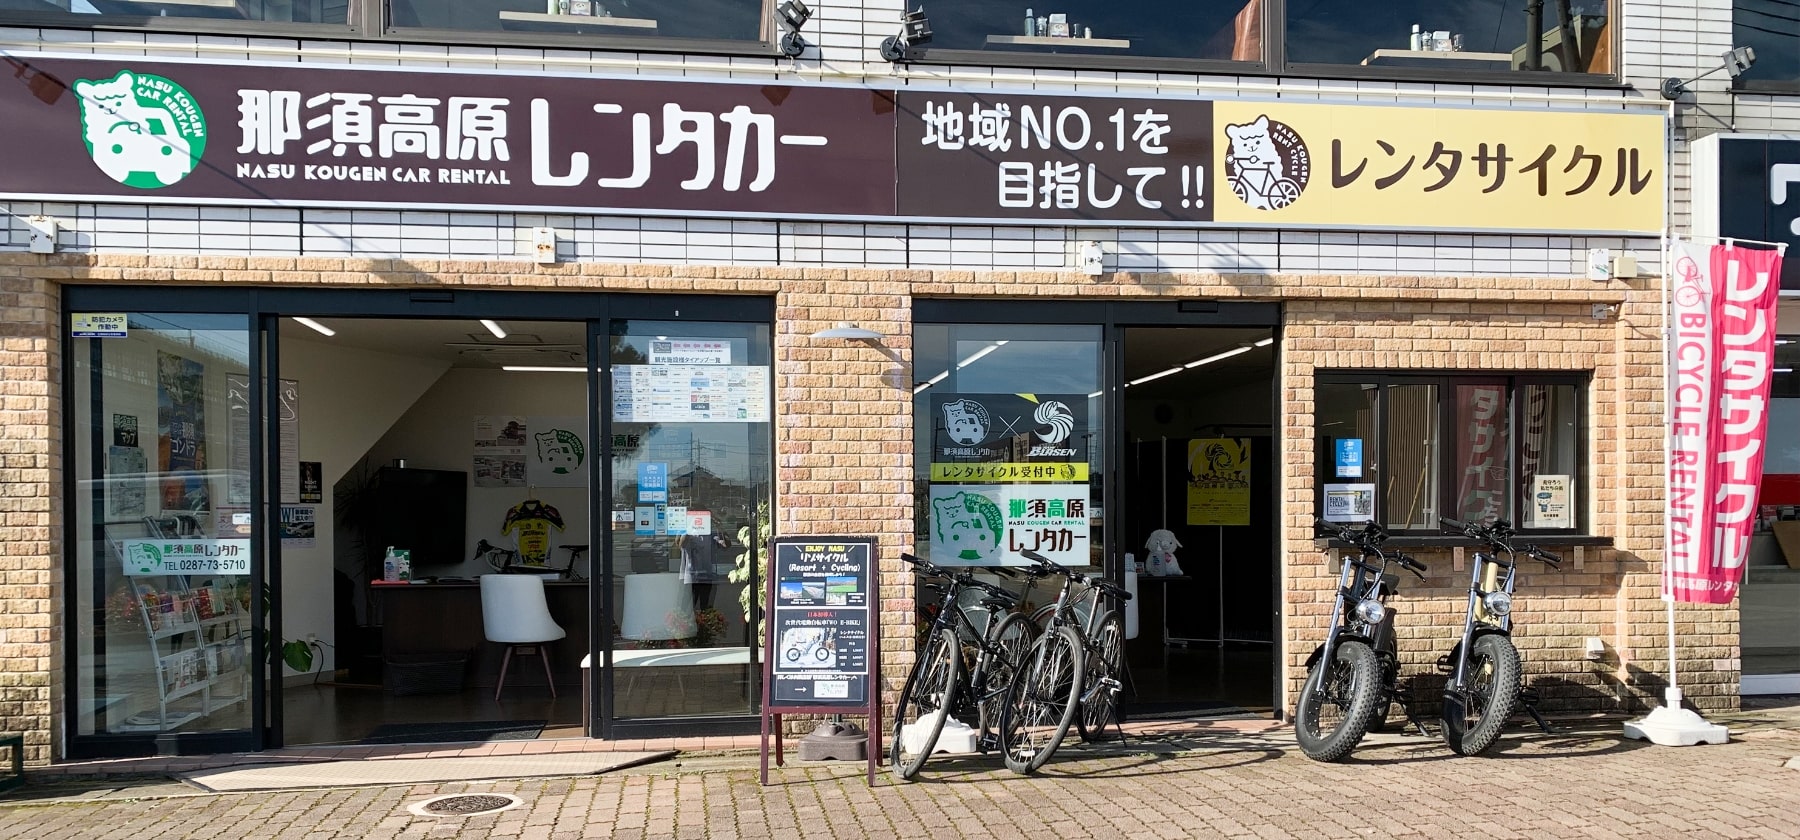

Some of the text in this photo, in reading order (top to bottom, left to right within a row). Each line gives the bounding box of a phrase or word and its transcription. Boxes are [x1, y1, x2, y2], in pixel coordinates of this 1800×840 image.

[136, 87, 192, 136] CAR RENTAL
[138, 76, 204, 137] NASU KOUGEN
[921, 101, 1171, 154] 地域NO.1を
[236, 89, 828, 192] 那須高原 レンタカー
[1273, 132, 1298, 176] RENT CYCLE
[1276, 124, 1308, 182] NASU KOUGEN
[236, 163, 510, 185] NASU KOUGEN CAR RENTAL
[1332, 138, 1652, 196] レンタサイクル
[1672, 313, 1706, 436] BICYCLE
[1713, 260, 1769, 568] レンタサイクル
[611, 434, 640, 447] 高原
[943, 466, 1055, 478] レンタサイクル受付中
[1009, 499, 1085, 518] 那須高原
[205, 545, 245, 556] レンタカー
[1009, 528, 1086, 552] レンタカー
[164, 560, 246, 570] TEL 0287-73-5710
